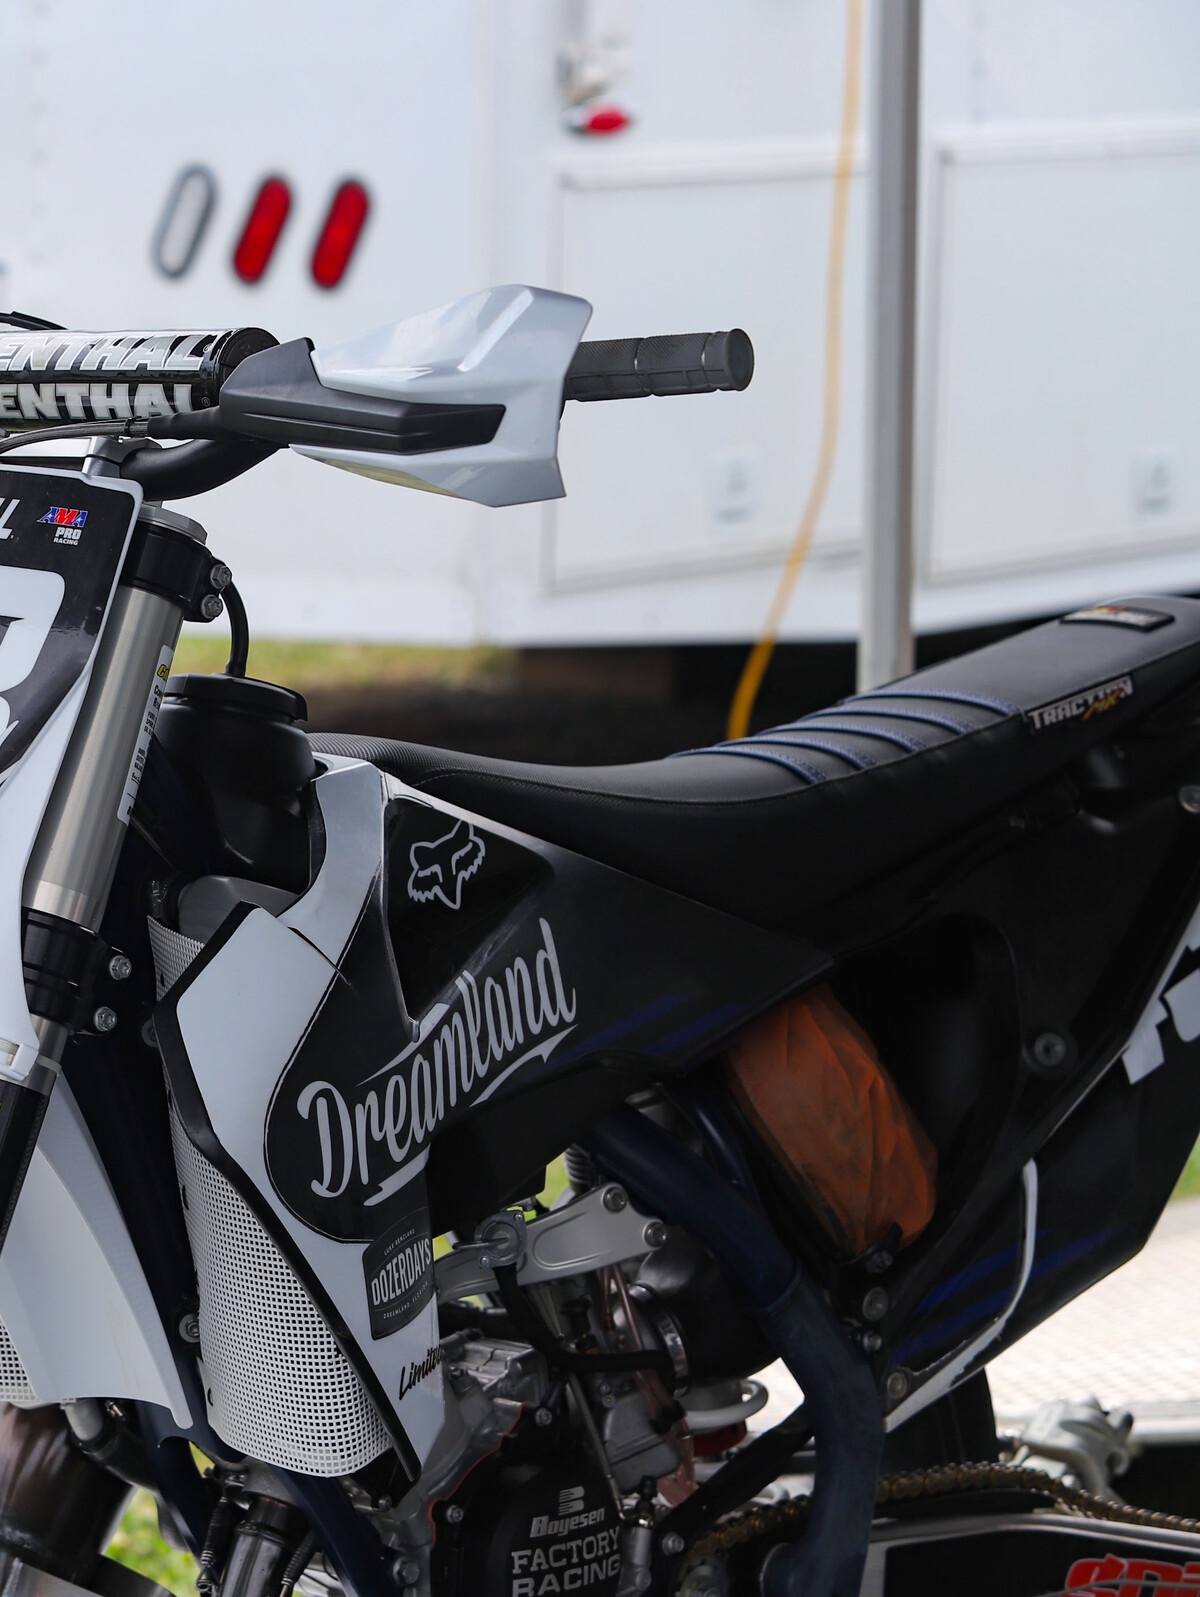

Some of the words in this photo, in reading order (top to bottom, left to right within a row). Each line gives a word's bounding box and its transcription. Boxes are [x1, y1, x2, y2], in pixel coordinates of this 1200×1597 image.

[37, 507, 88, 527] AMA
[55, 527, 82, 539] PRO
[297, 918, 576, 1198] Dreamland
[371, 1238, 431, 1306] DOZERDAYS
[530, 1508, 605, 1538] Boyesen
[511, 1526, 620, 1574] FACTORY
[512, 1554, 620, 1597] RACING
